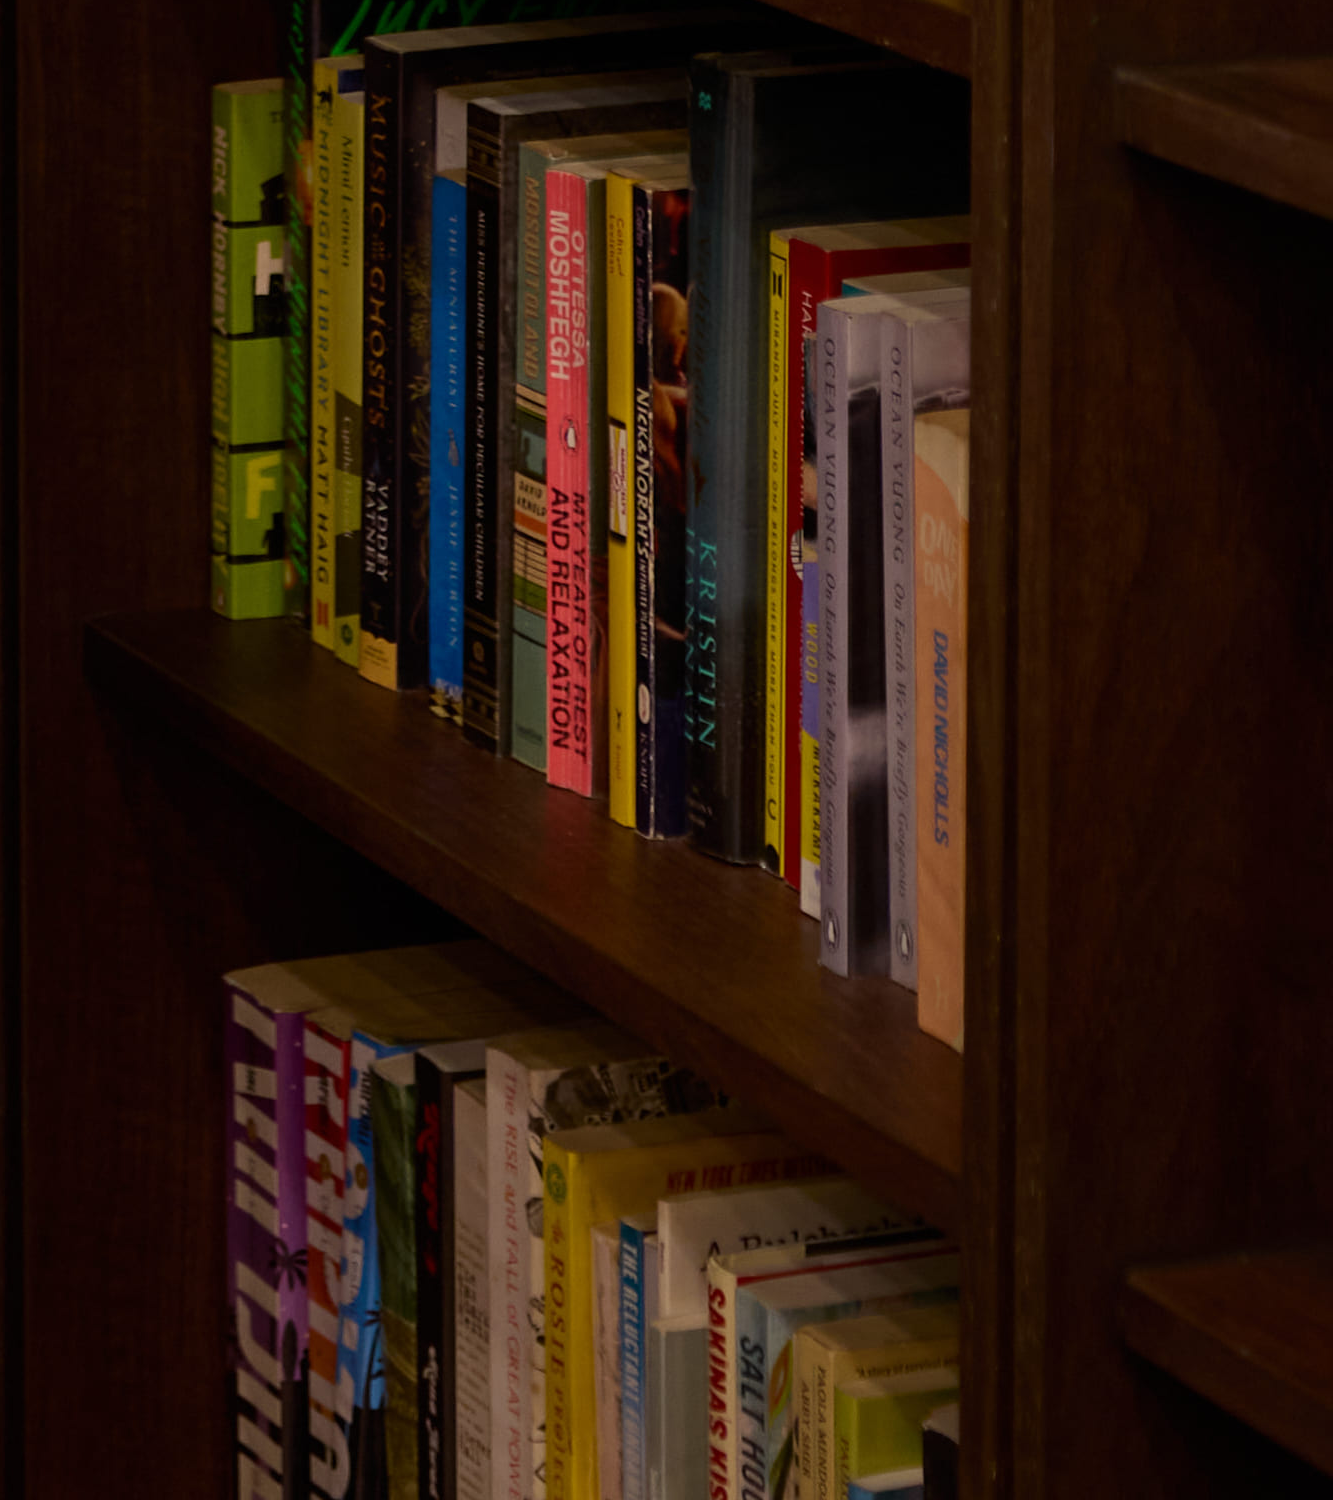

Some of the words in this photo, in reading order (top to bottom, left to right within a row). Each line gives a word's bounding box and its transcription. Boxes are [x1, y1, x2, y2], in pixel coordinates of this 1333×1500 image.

[548, 210, 571, 380] MOSHFEGH
[551, 488, 571, 550] AND
[550, 560, 571, 751] RELAXATION
